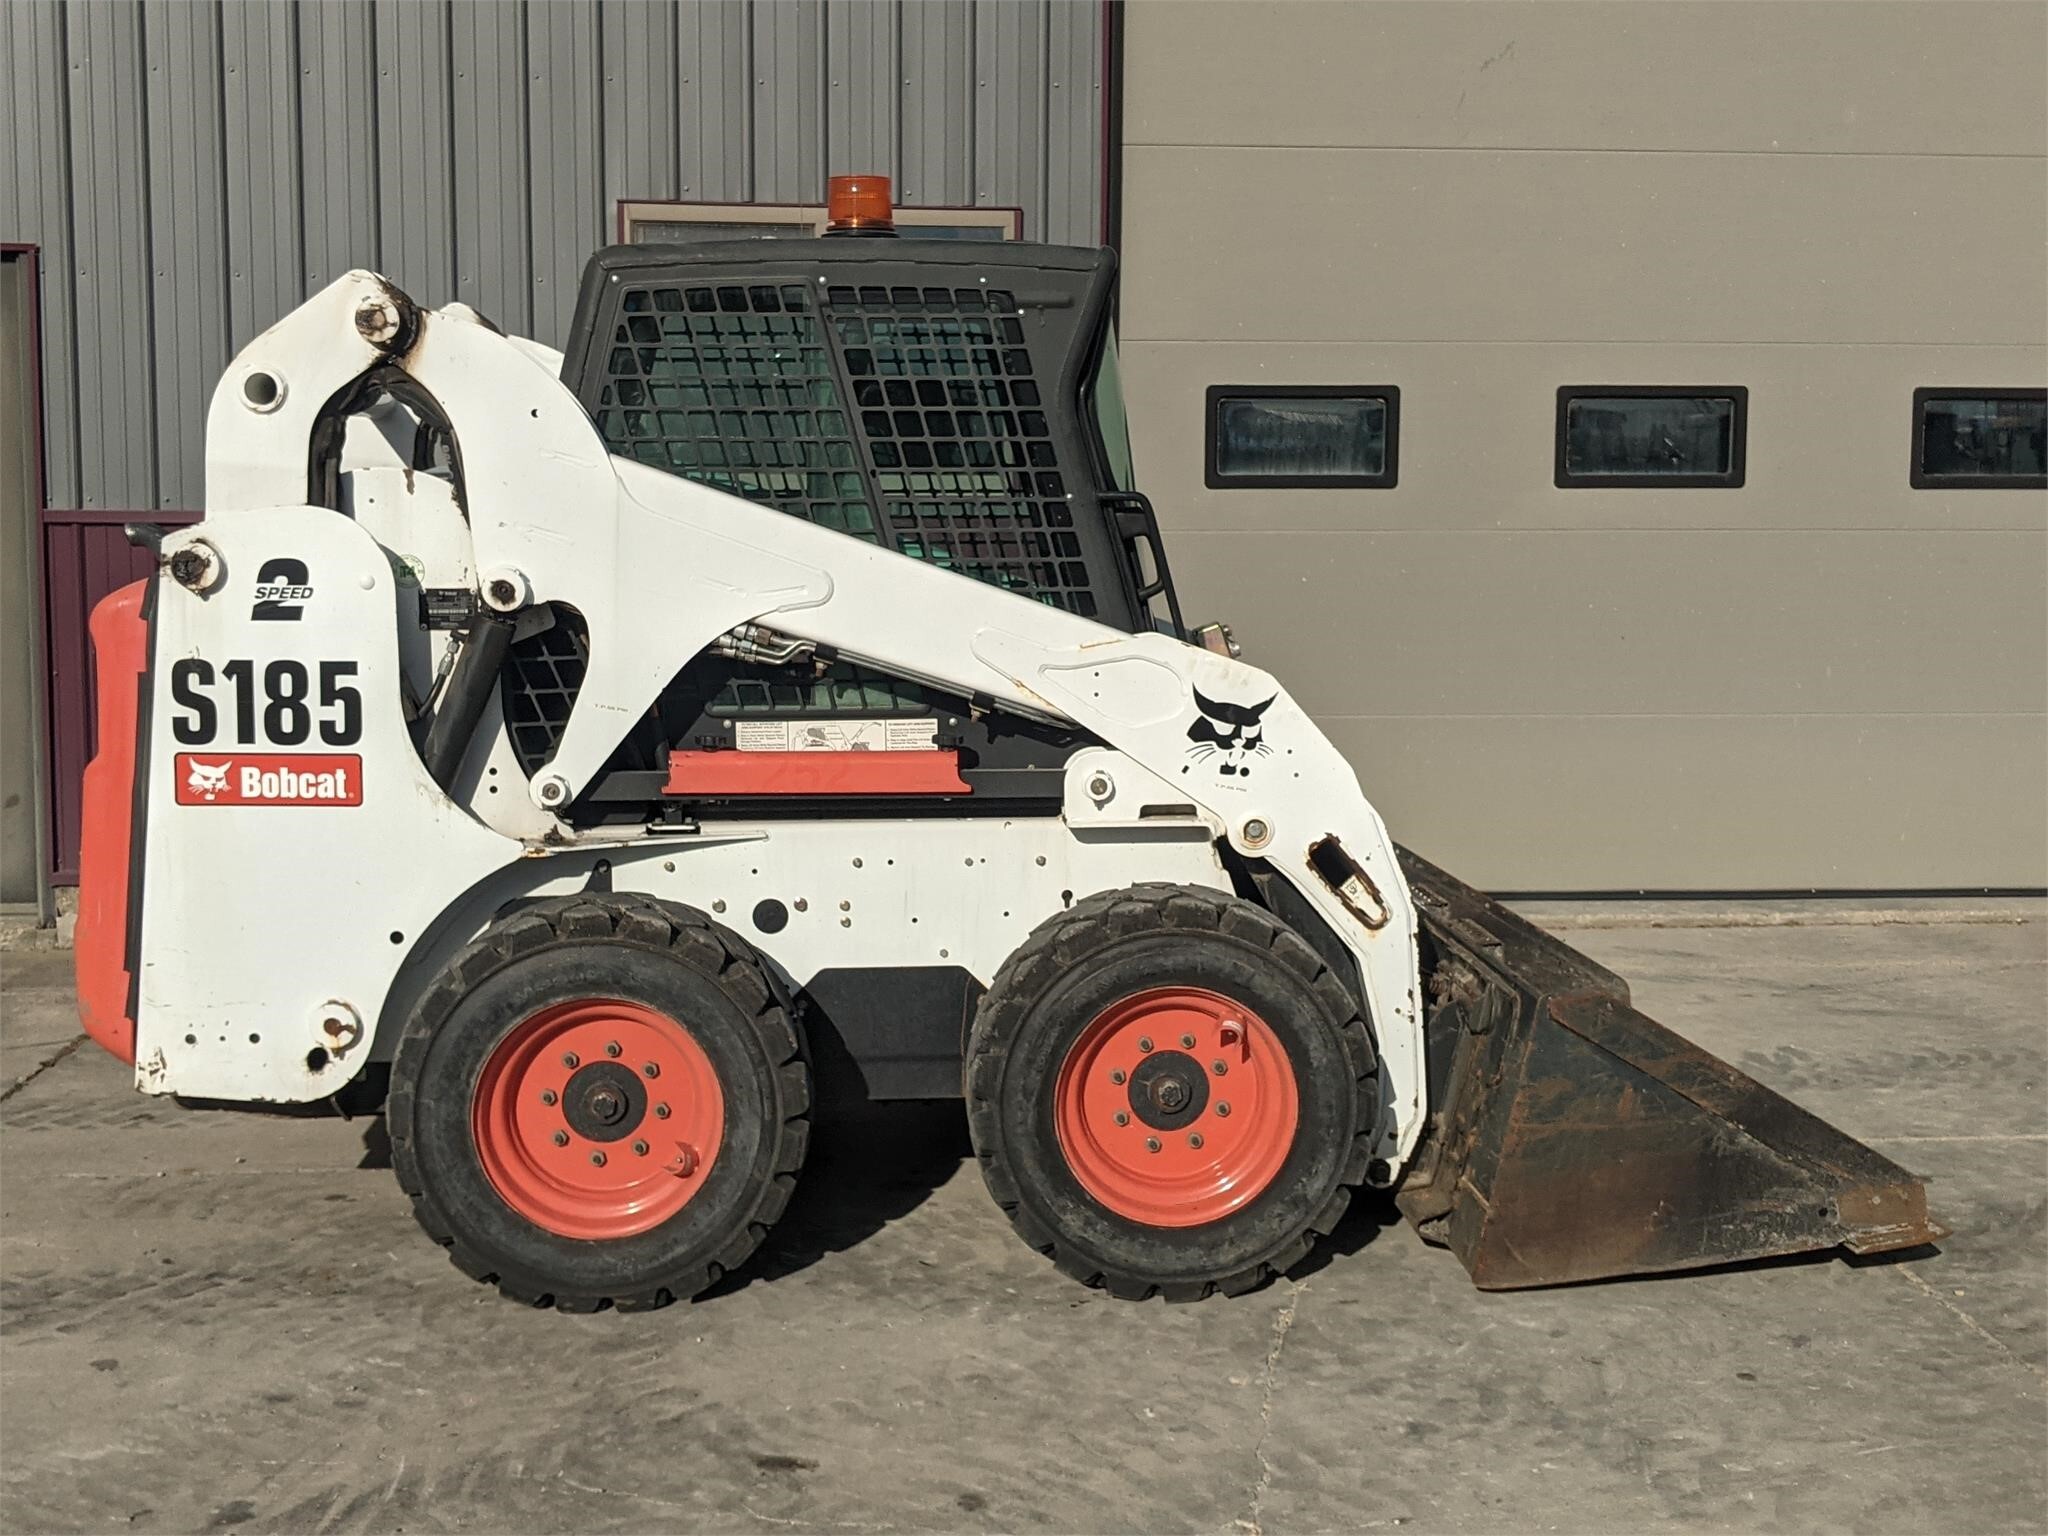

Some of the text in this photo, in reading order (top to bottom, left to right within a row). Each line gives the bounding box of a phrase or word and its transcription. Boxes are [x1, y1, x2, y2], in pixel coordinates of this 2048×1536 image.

[251, 558, 314, 621] 2 SPEED
[171, 659, 362, 746] S185
[240, 766, 347, 799] Bobcat
